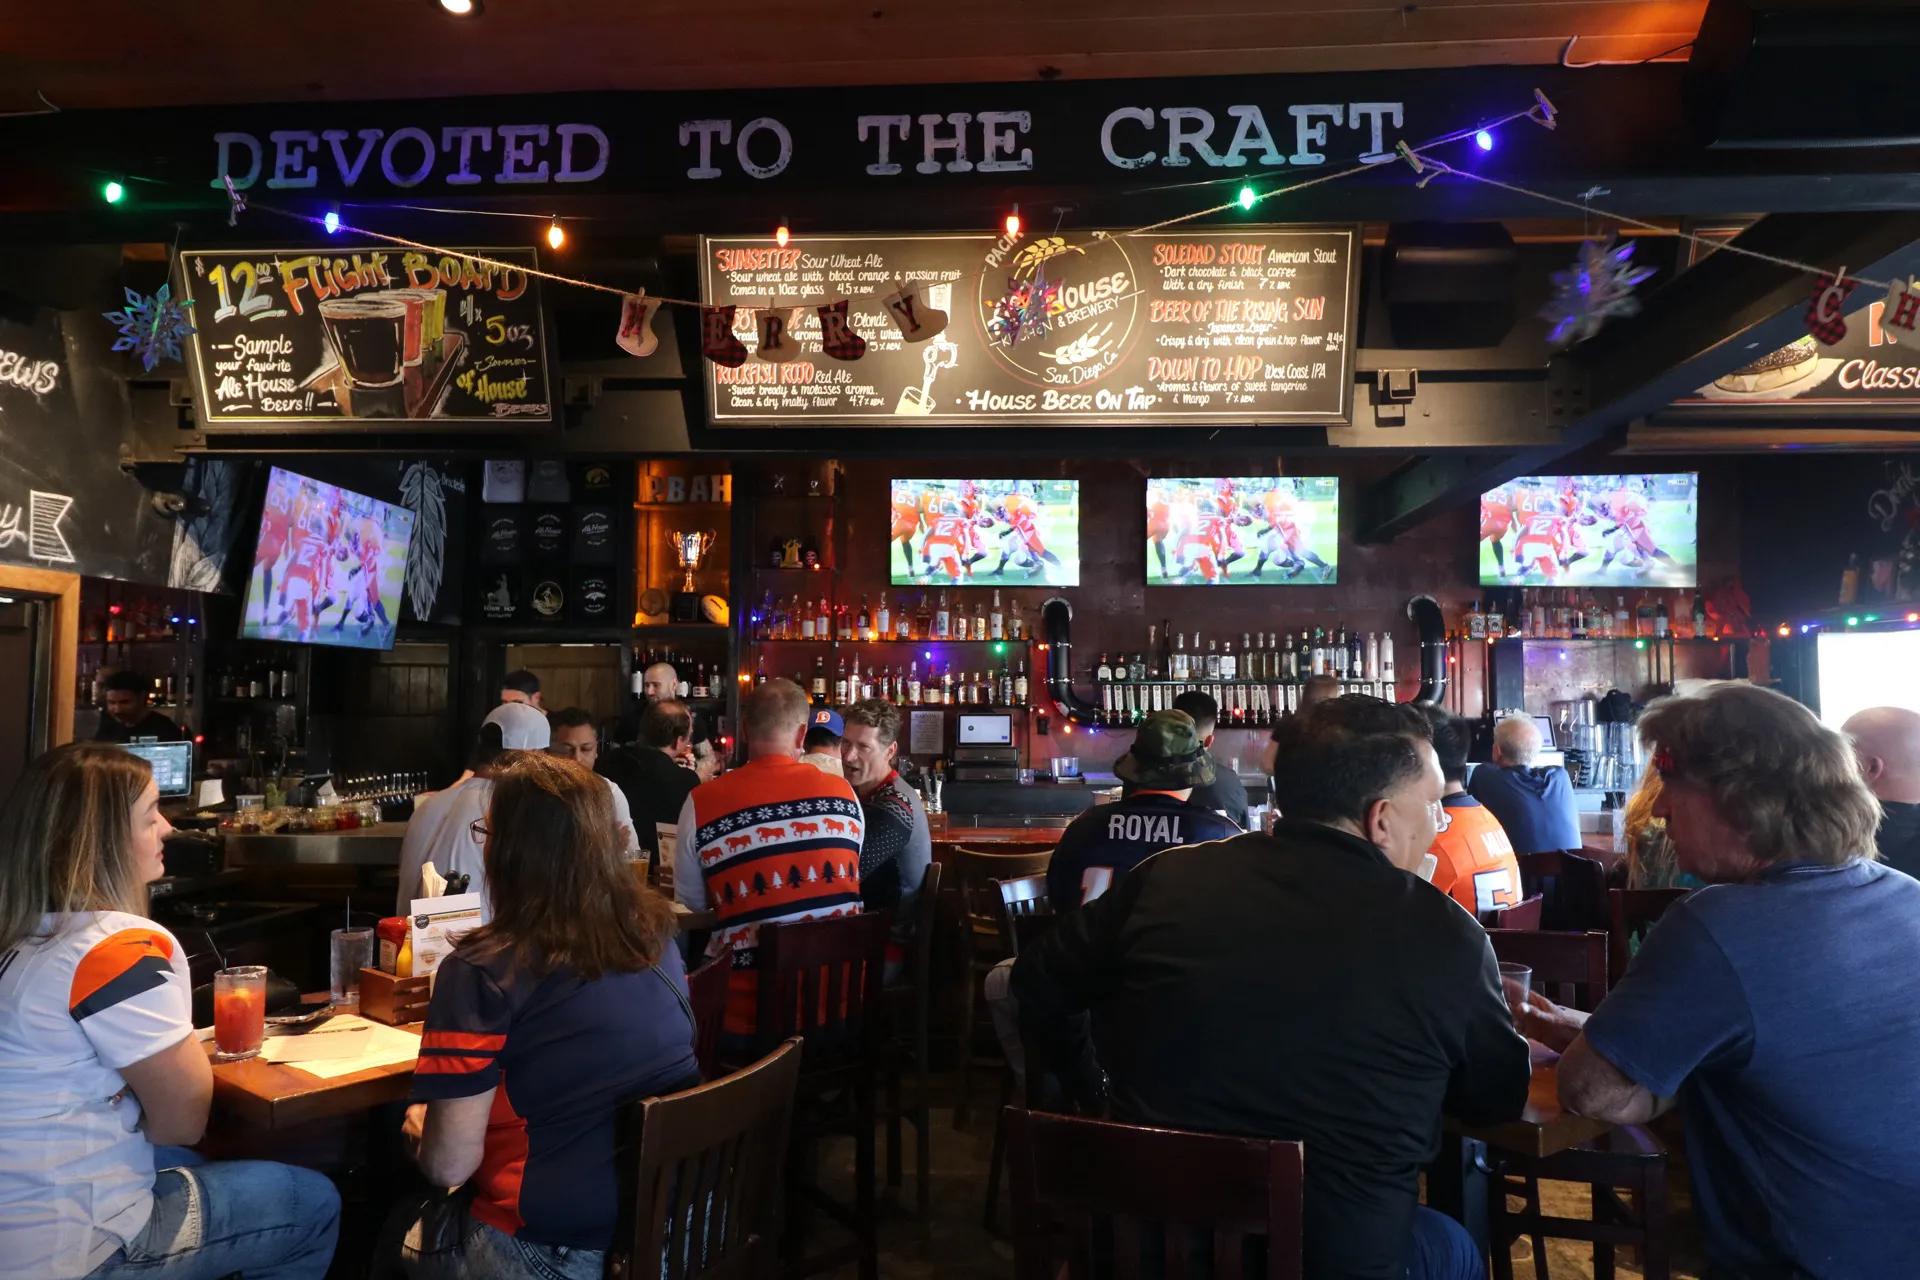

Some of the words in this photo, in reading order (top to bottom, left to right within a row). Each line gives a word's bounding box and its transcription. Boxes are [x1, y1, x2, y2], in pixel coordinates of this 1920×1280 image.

[210, 123, 610, 189] DEVOTED
[679, 117, 793, 180] TO
[857, 110, 1033, 176] THE
[1100, 102, 1404, 170] CRAFT
[716, 248, 801, 272] SUNSETTER
[801, 254, 829, 269] Sour
[830, 254, 862, 268] Wheat
[864, 253, 883, 268] Ale
[1153, 244, 1217, 266] SOLEDAD
[1218, 244, 1267, 266] STOUT
[1267, 248, 1311, 265] American
[1313, 248, 1337, 264] Stout
[730, 271, 754, 283] Sour
[756, 271, 781, 282] wheat
[784, 271, 799, 282] ale
[802, 271, 824, 282] with
[829, 270, 855, 282] blood
[858, 271, 891, 283] orange
[894, 271, 902, 280] &
[905, 270, 938, 283] passion
[940, 269, 962, 281] fruit
[1164, 266, 1186, 278] Dark
[1188, 266, 1227, 277] chocolate
[1229, 267, 1237, 278] &
[1241, 266, 1263, 278] black
[1267, 267, 1297, 278] coffee
[730, 284, 756, 296] Comes
[757, 285, 767, 296] in
[768, 286, 776, 296] a
[800, 284, 825, 299] glass
[1187, 281, 1194, 290] a
[1196, 279, 1214, 293] dry
[1217, 279, 1245, 290] finish
[1066, 296, 1120, 324] BREWERY
[1150, 300, 1191, 324] BEER
[1192, 299, 1213, 322] OF
[1215, 299, 1241, 322] THE
[1293, 296, 1326, 322] SUN
[853, 312, 889, 328] Blonde
[234, 334, 294, 361] Sample
[1160, 335, 1186, 349] Crispy
[1187, 335, 1194, 346] &
[1195, 335, 1210, 349] dry
[1213, 334, 1232, 347] with
[1300, 334, 1323, 345] flavor
[0, 349, 59, 394] EWS
[215, 360, 243, 376] your
[246, 359, 292, 374] favorite
[1043, 366, 1071, 384] San
[1147, 356, 1200, 381] DOWN
[1201, 356, 1222, 381] TO
[1223, 354, 1263, 381] HOP
[1264, 364, 1286, 380] West
[1286, 363, 1309, 379] Coast
[1310, 362, 1326, 379] IPA
[815, 370, 832, 384] Red
[834, 369, 853, 384] Ale
[214, 376, 244, 401] Ale
[243, 373, 299, 400] House
[474, 374, 528, 403] House
[731, 385, 756, 396] Sweet
[791, 385, 798, 395] &
[801, 385, 841, 395] molasses
[1159, 381, 1191, 392] Aromas
[1191, 381, 1199, 392] &
[1199, 380, 1227, 392] flavors
[1231, 381, 1241, 391] of
[1244, 382, 1268, 392] sweet
[1271, 381, 1308, 394] tangerine
[731, 397, 753, 408] Clean
[756, 397, 763, 407] &
[764, 396, 779, 410] dry
[782, 397, 808, 410] malty
[812, 396, 838, 407] flavor
[1173, 393, 1180, 404] &
[1108, 814, 1184, 844] ROYAL
